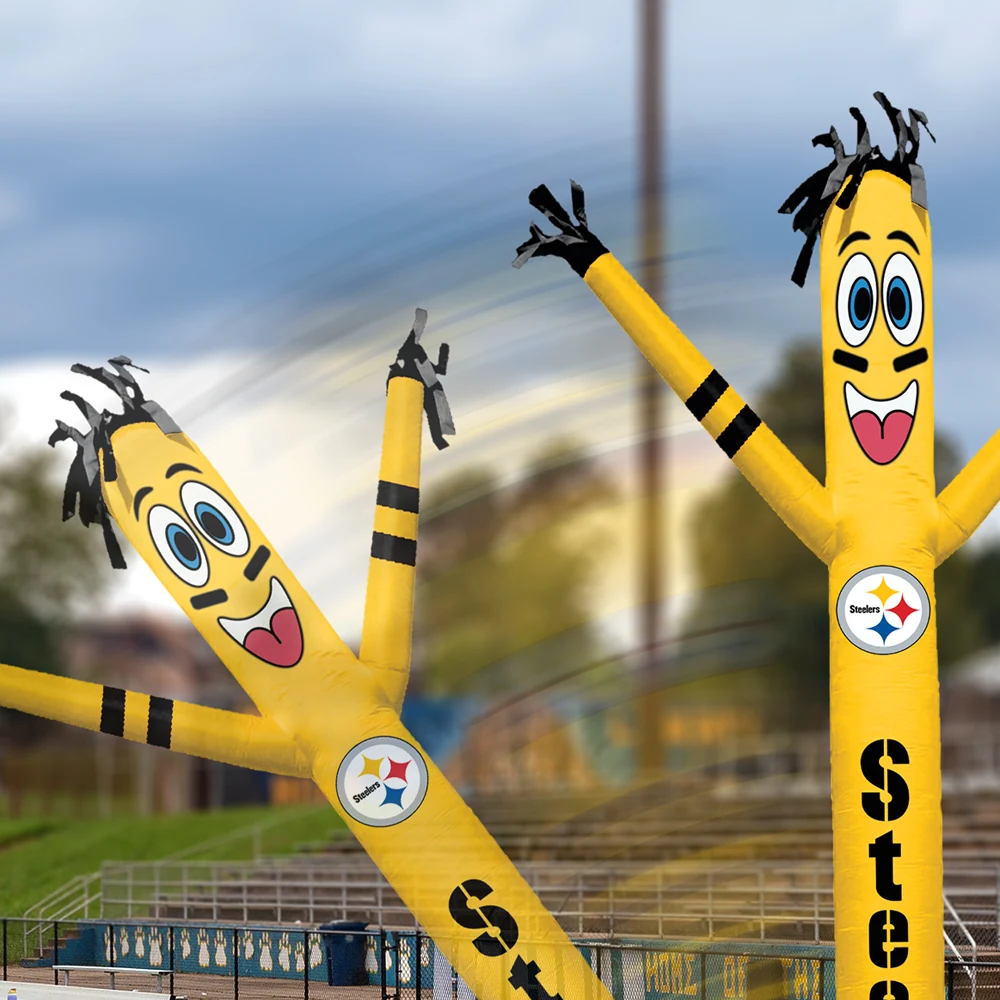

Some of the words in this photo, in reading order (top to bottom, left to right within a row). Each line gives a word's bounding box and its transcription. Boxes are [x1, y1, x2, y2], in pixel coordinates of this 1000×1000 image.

[849, 604, 881, 614] Steelers
[352, 781, 381, 804] Steelers
[645, 951, 697, 995] HOME
[723, 955, 749, 997] OF
